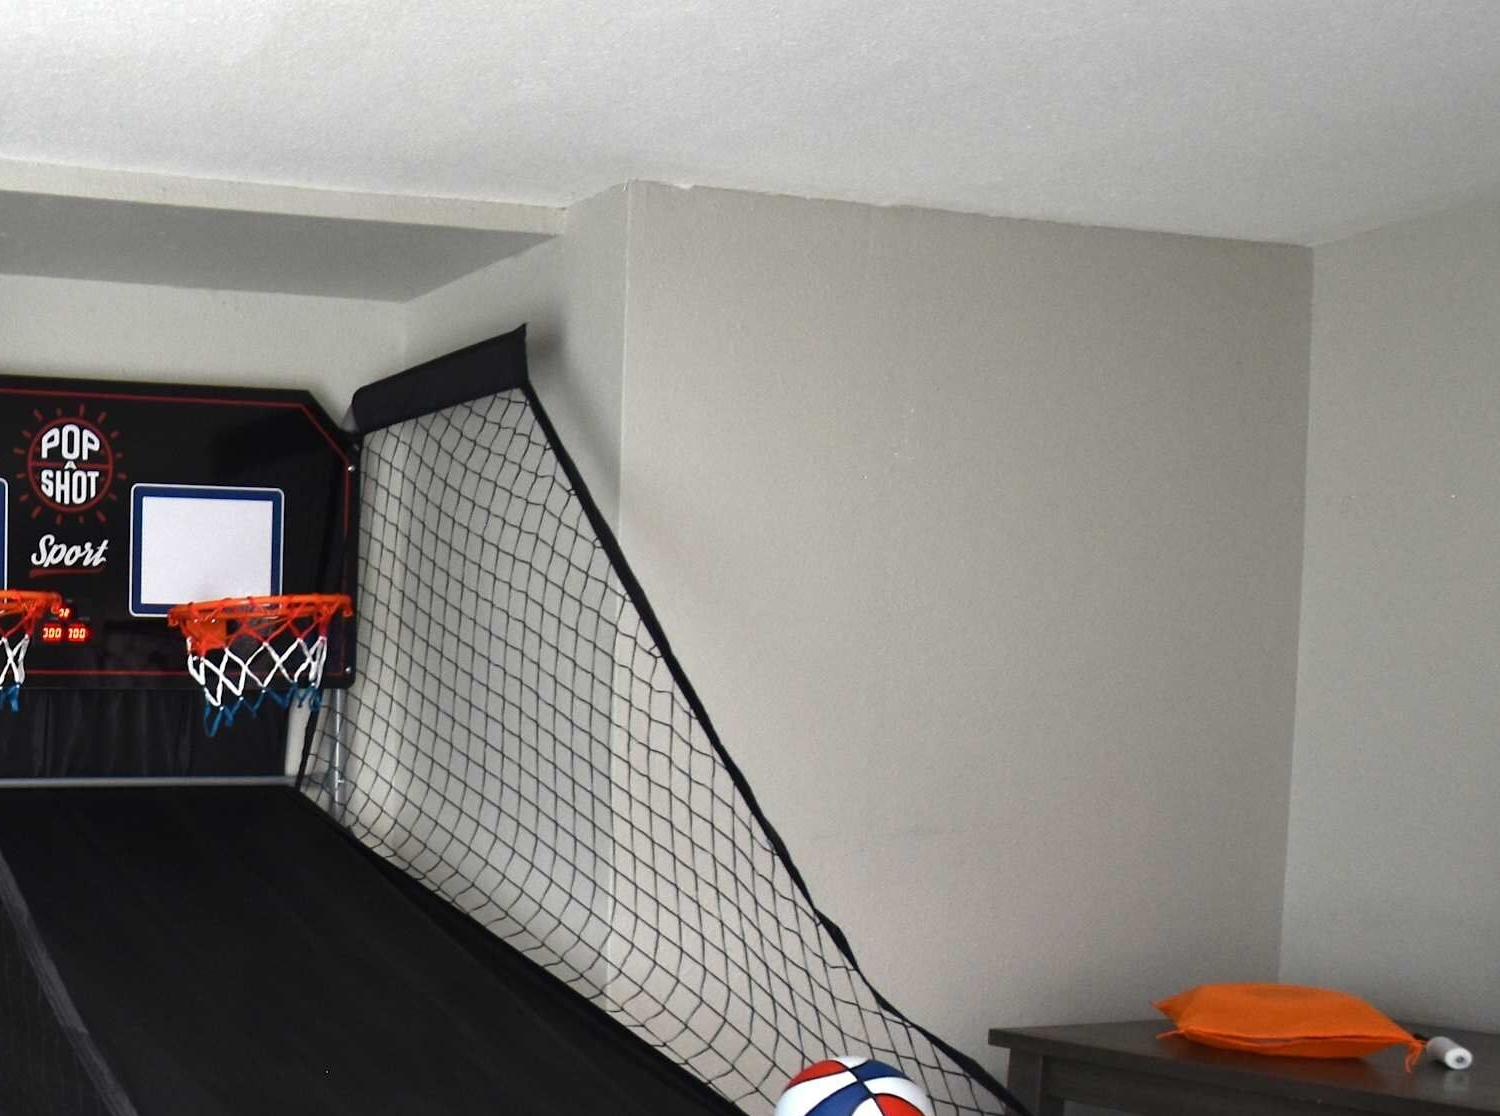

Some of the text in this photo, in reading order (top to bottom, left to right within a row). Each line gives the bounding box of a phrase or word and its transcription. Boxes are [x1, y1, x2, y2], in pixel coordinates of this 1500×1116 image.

[41, 424, 100, 460] POP
[41, 469, 100, 505] SHOT
[30, 534, 109, 568] Sport
